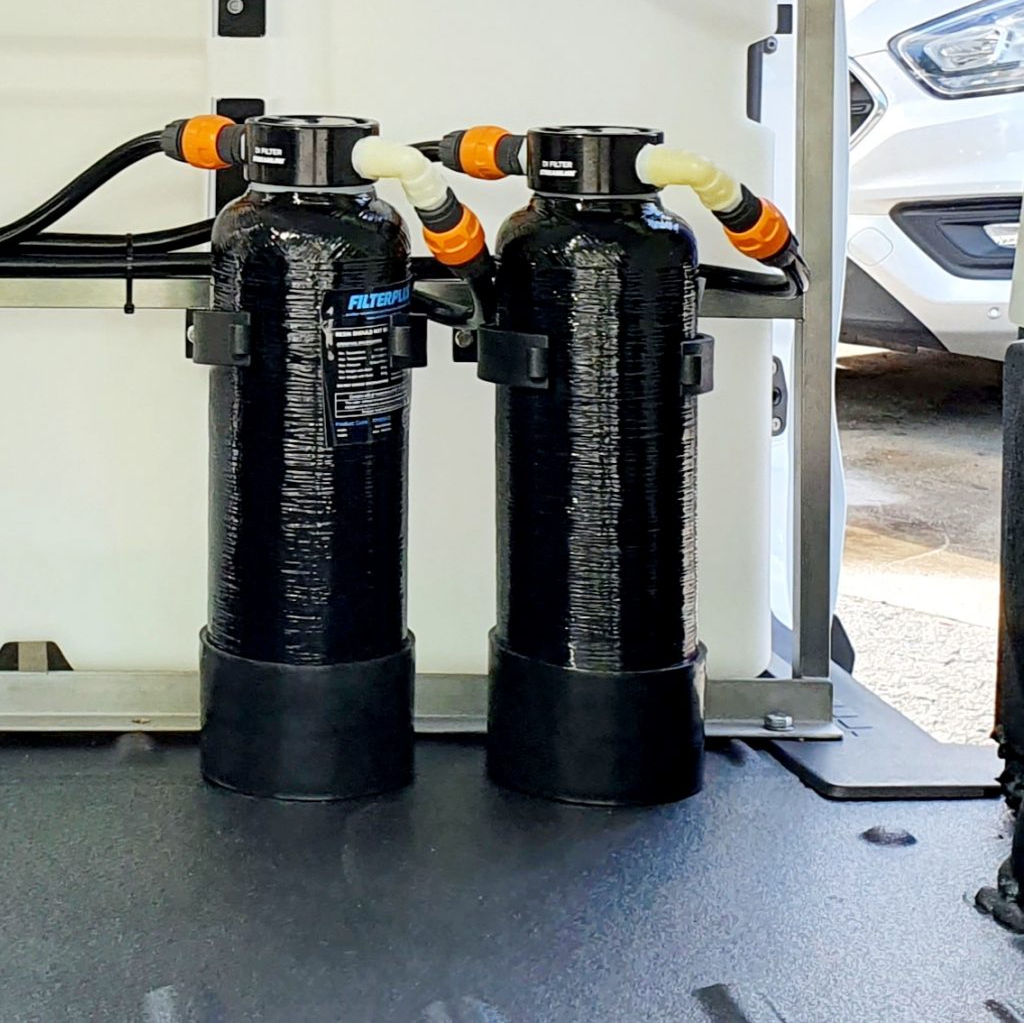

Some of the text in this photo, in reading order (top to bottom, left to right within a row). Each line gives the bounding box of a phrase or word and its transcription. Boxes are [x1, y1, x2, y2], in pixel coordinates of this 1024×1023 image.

[261, 147, 283, 156] FILTER
[549, 160, 573, 169] FILTER
[347, 285, 410, 310] FILTERPLU
